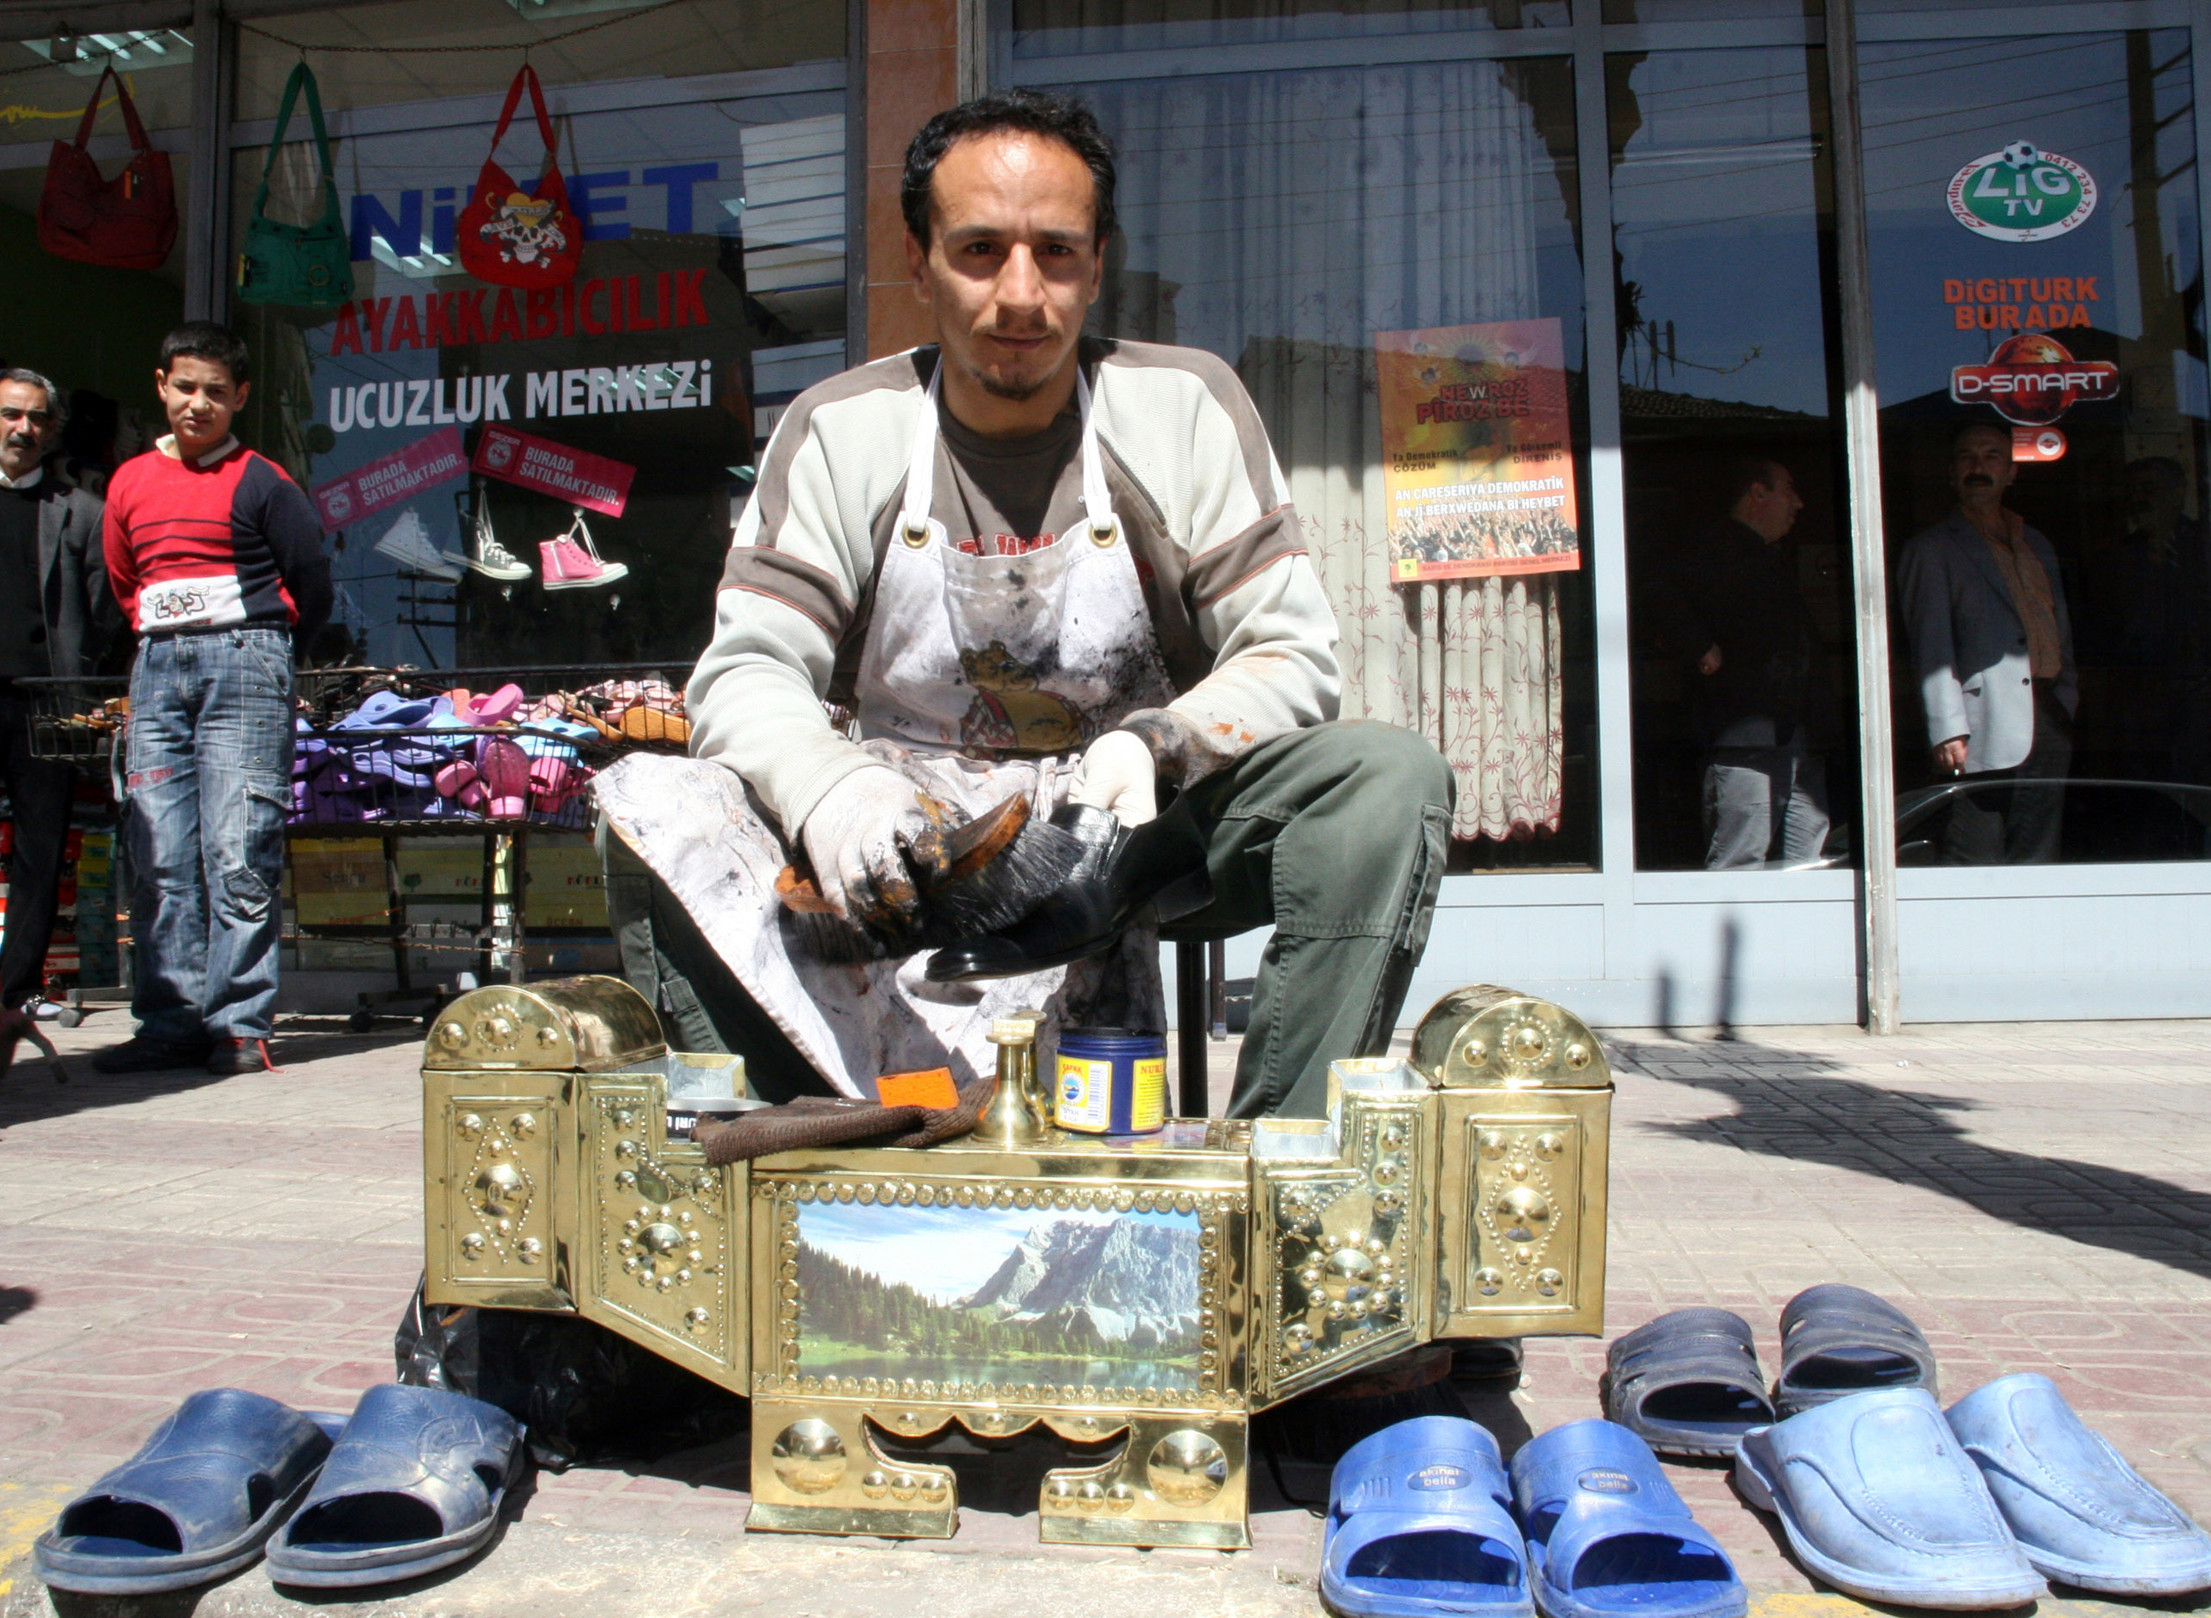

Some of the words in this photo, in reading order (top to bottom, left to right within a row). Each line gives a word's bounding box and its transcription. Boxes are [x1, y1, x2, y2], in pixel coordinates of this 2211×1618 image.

[2045, 153, 2077, 172] 0412
[2077, 173, 2093, 195] 234
[351, 162, 718, 261] NiET
[2003, 199, 2044, 216] TV
[2077, 199, 2091, 215] 73
[2061, 217, 2079, 229] 73
[330, 268, 710, 357] AYAKKABICILIK
[1955, 304, 2092, 330] BURADA
[1440, 379, 1529, 402] NEWROZ
[1958, 372, 2110, 394] D-SMART
[330, 375, 511, 433] UCUZLUK
[525, 447, 575, 474] BURADA
[358, 461, 408, 491] BURADA
[362, 453, 463, 506] SATILMAKTADIR.
[520, 462, 620, 505] SATILMAKTADIR.
[1395, 489, 1411, 501] AN
[1396, 507, 1412, 518] AN
[1522, 494, 1566, 510] HEYBET
